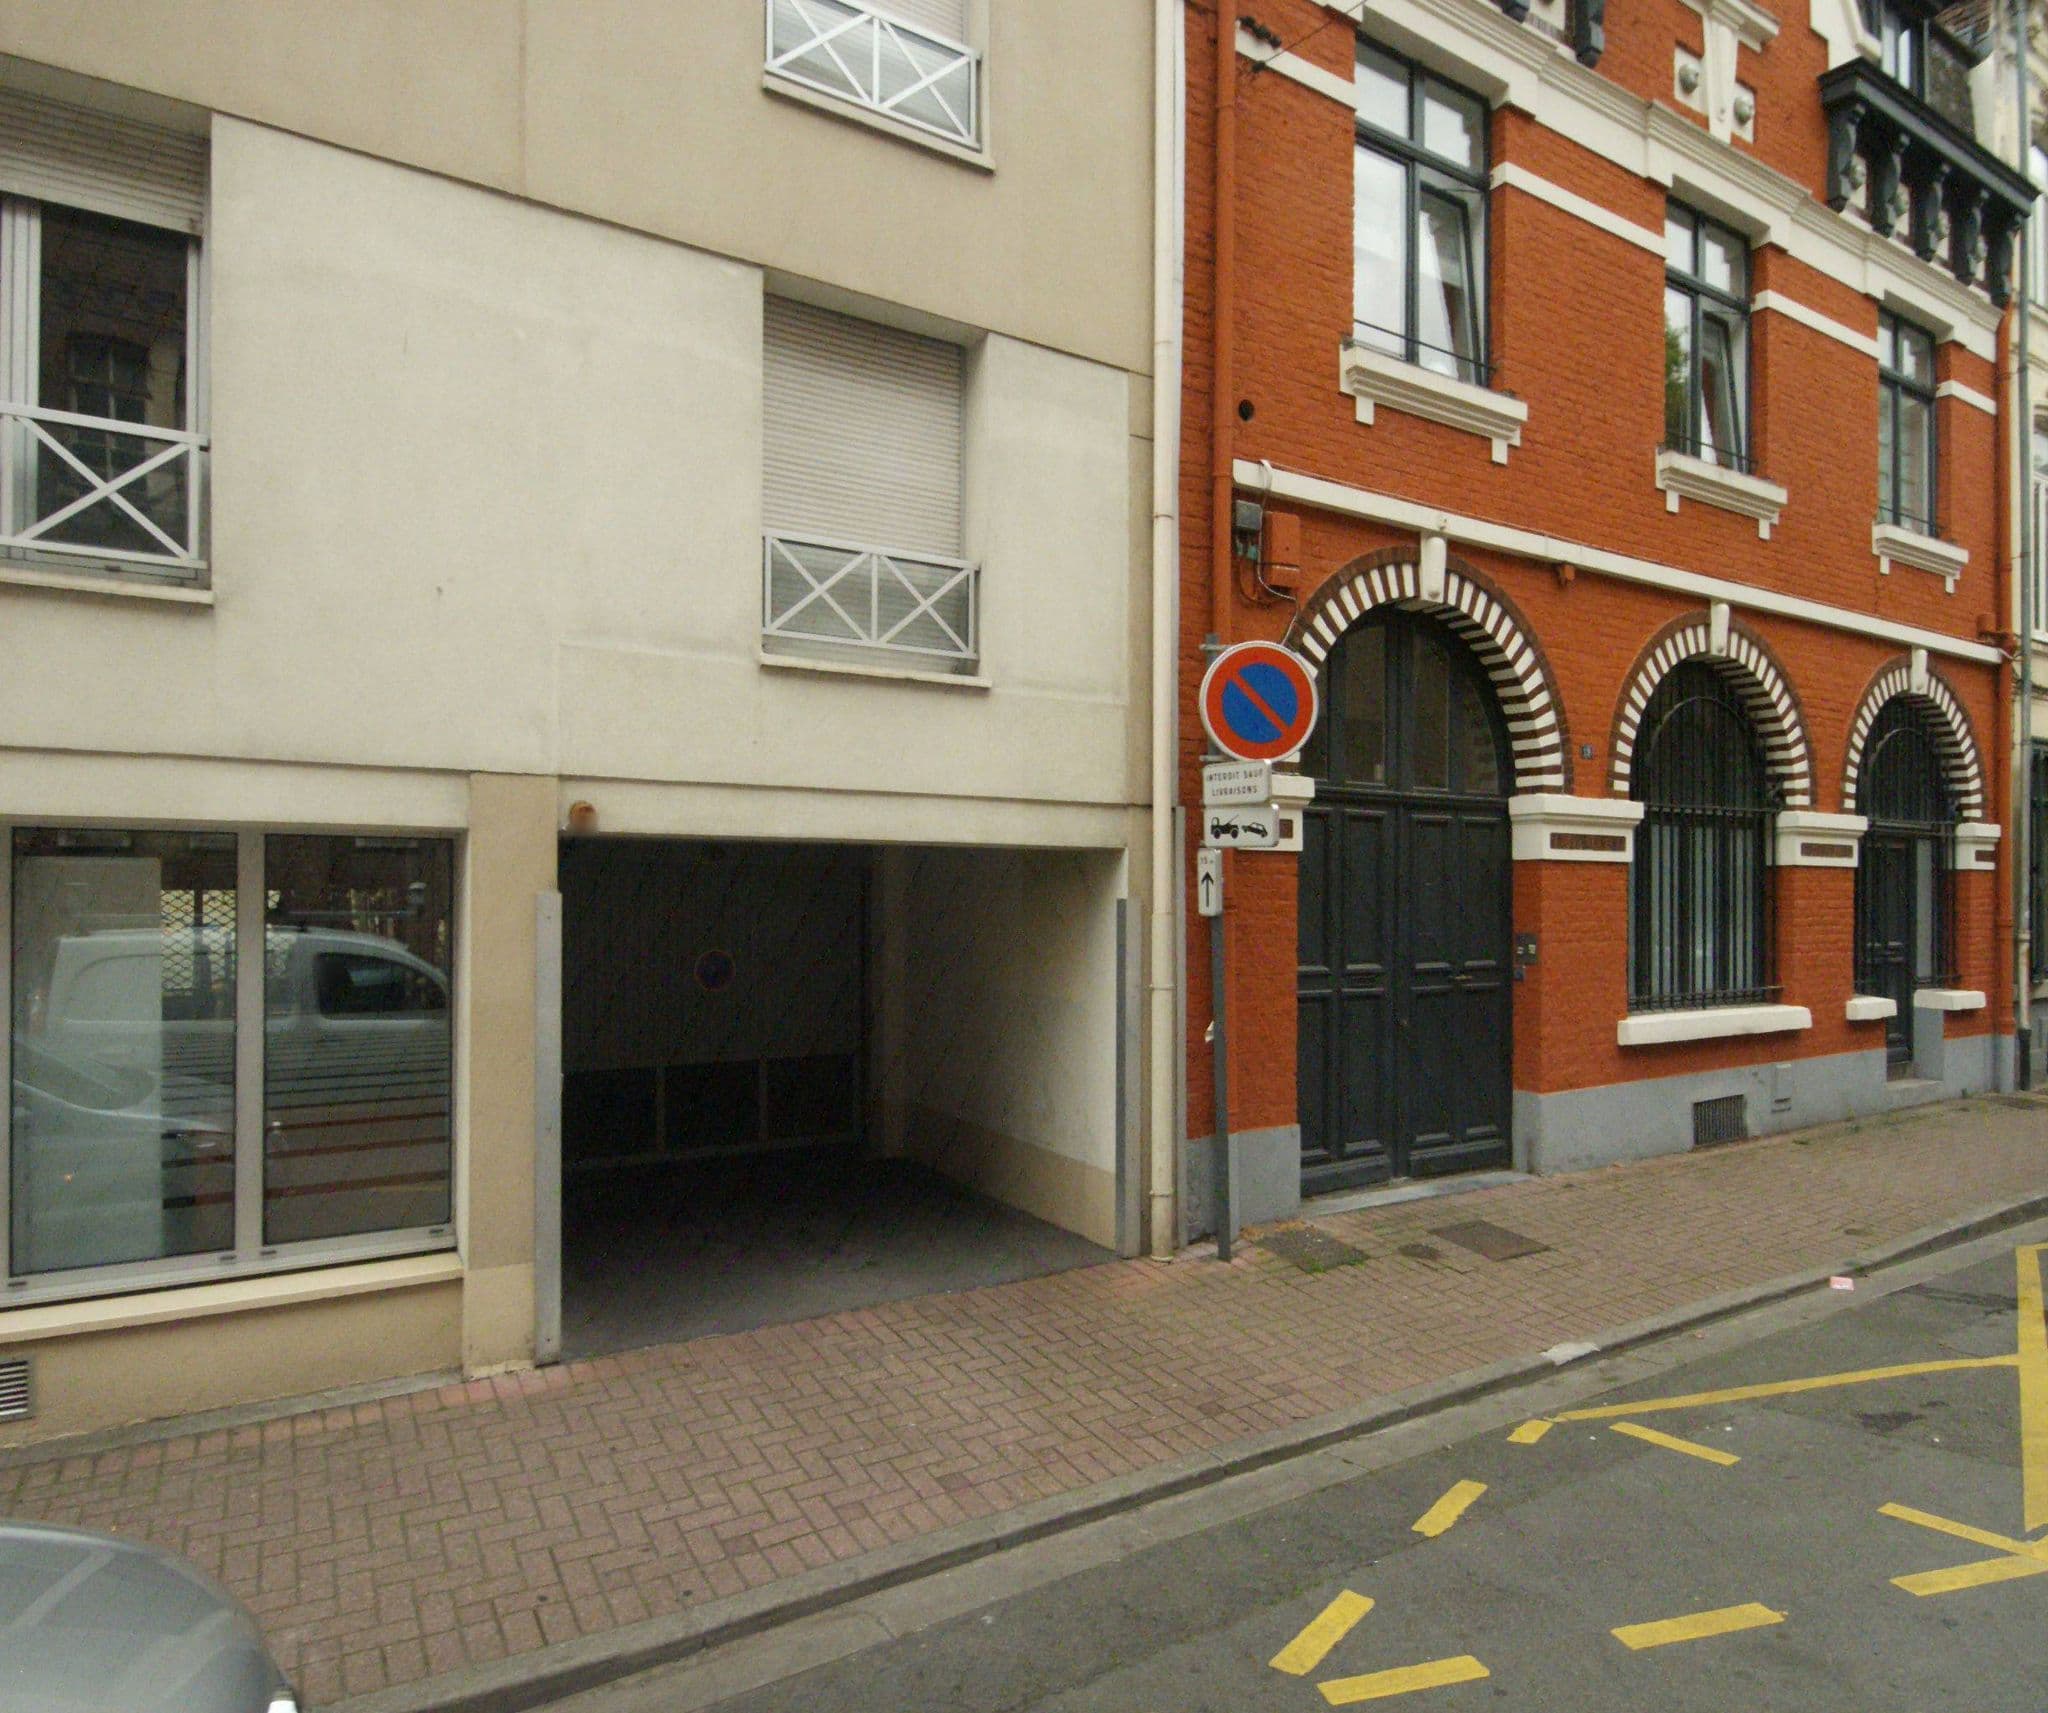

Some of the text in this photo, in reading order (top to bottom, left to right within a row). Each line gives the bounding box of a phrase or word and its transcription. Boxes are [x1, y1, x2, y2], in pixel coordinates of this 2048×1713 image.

[1206, 768, 1263, 782] INTERDIT SAUF
[1211, 785, 1258, 797] LIVRAISONS
